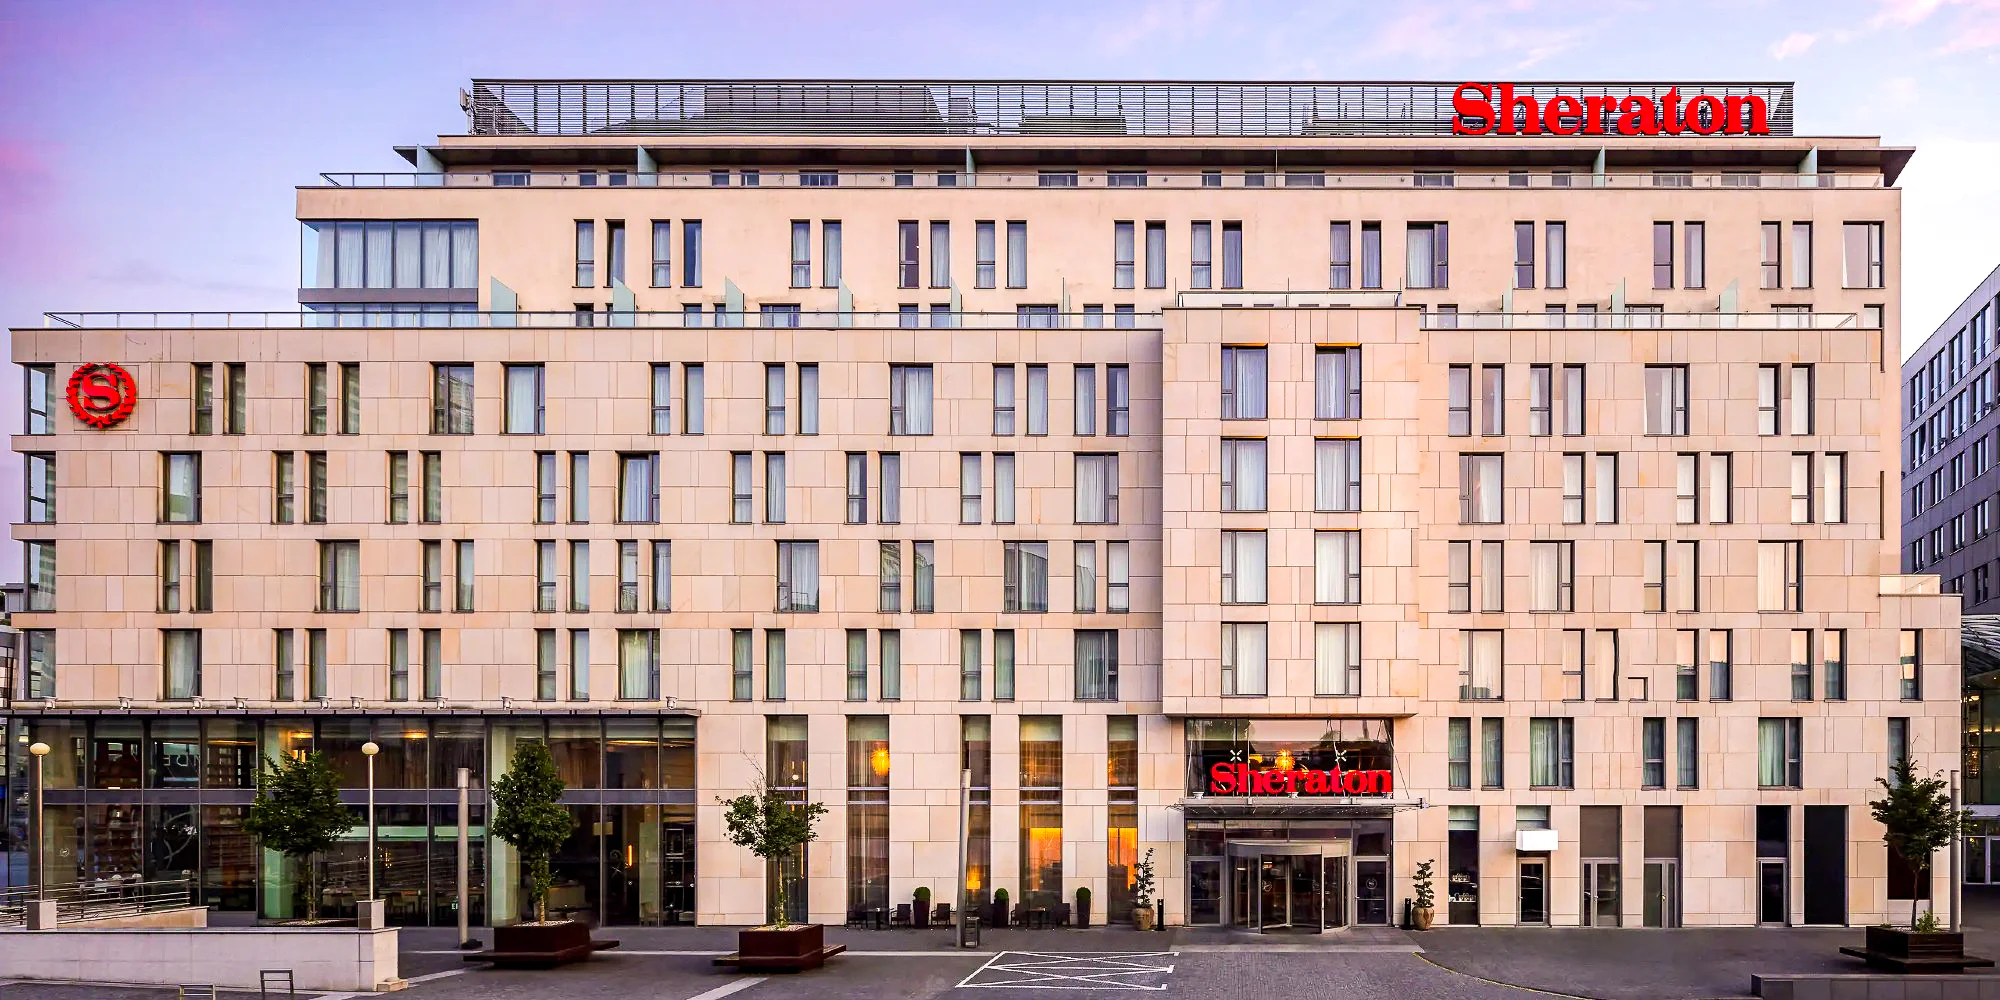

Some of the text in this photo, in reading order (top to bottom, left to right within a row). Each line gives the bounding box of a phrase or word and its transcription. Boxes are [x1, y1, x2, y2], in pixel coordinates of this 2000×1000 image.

[1452, 82, 1770, 136] Sheraton
[82, 372, 121, 411] S
[1211, 762, 1393, 794] Sheraton
